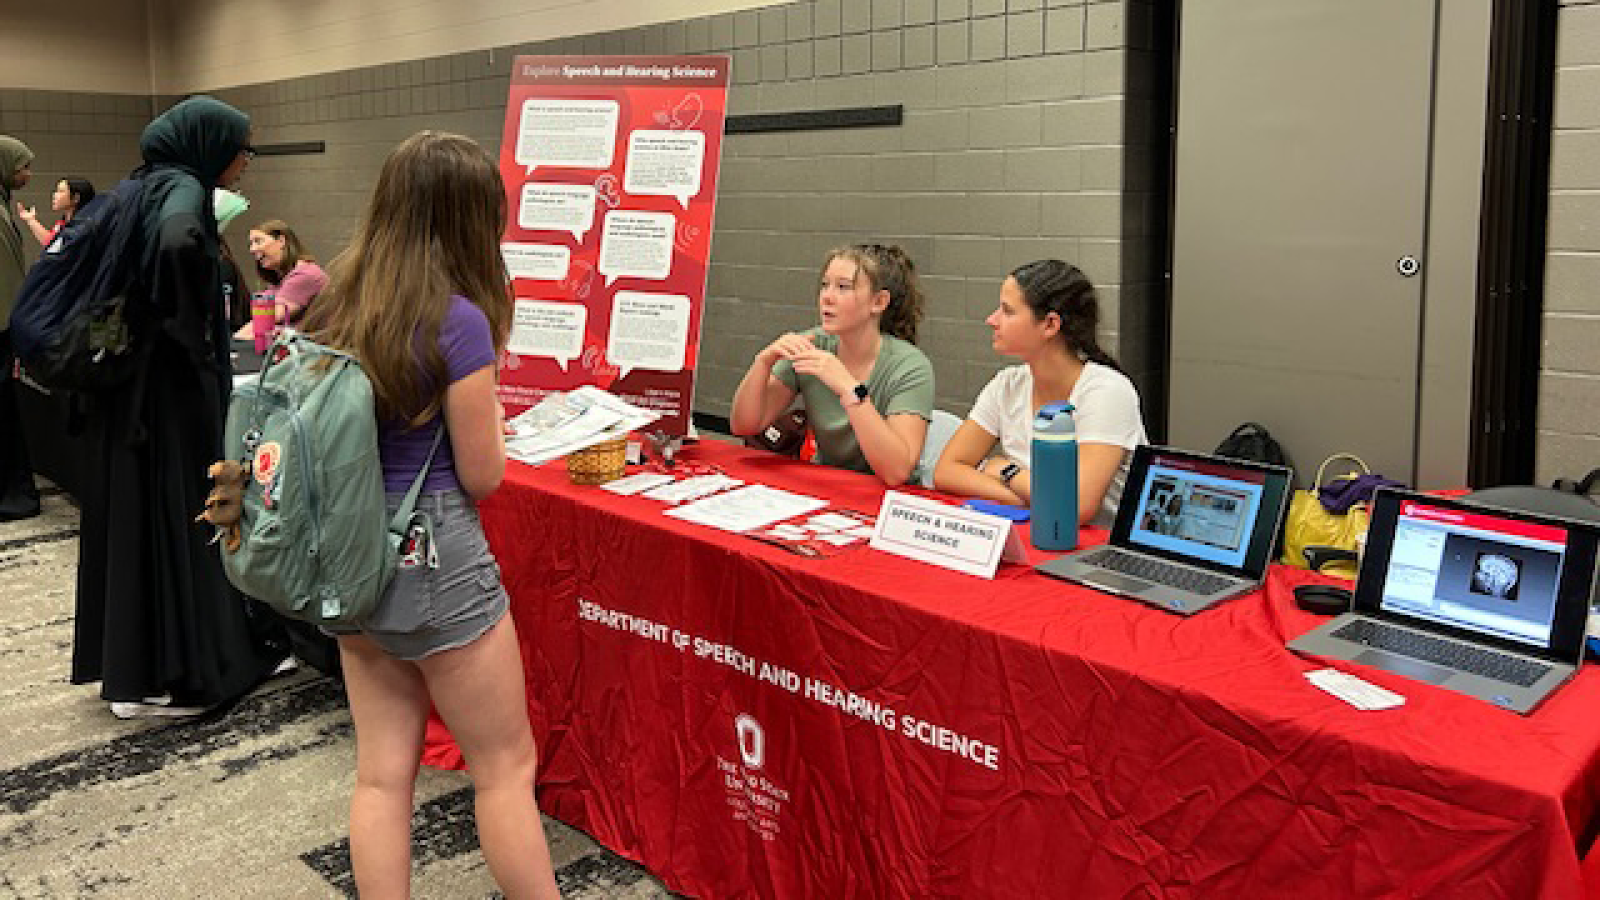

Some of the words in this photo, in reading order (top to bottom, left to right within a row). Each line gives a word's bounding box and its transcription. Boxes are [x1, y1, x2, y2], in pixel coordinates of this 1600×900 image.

[521, 64, 560, 79] Explore
[562, 64, 600, 79] Speech
[602, 65, 623, 77] and
[624, 64, 670, 80] Hearing
[671, 65, 716, 78] Science
[891, 507, 931, 525] SPEECH
[934, 517, 941, 528] &
[944, 521, 993, 540] HEARING
[914, 529, 960, 548] SCIENCE
[671, 629, 690, 652] OF
[693, 637, 756, 677] SPEECH
[758, 661, 800, 693] AND
[804, 676, 896, 731] HEARING
[900, 715, 999, 770] SCIENCE
